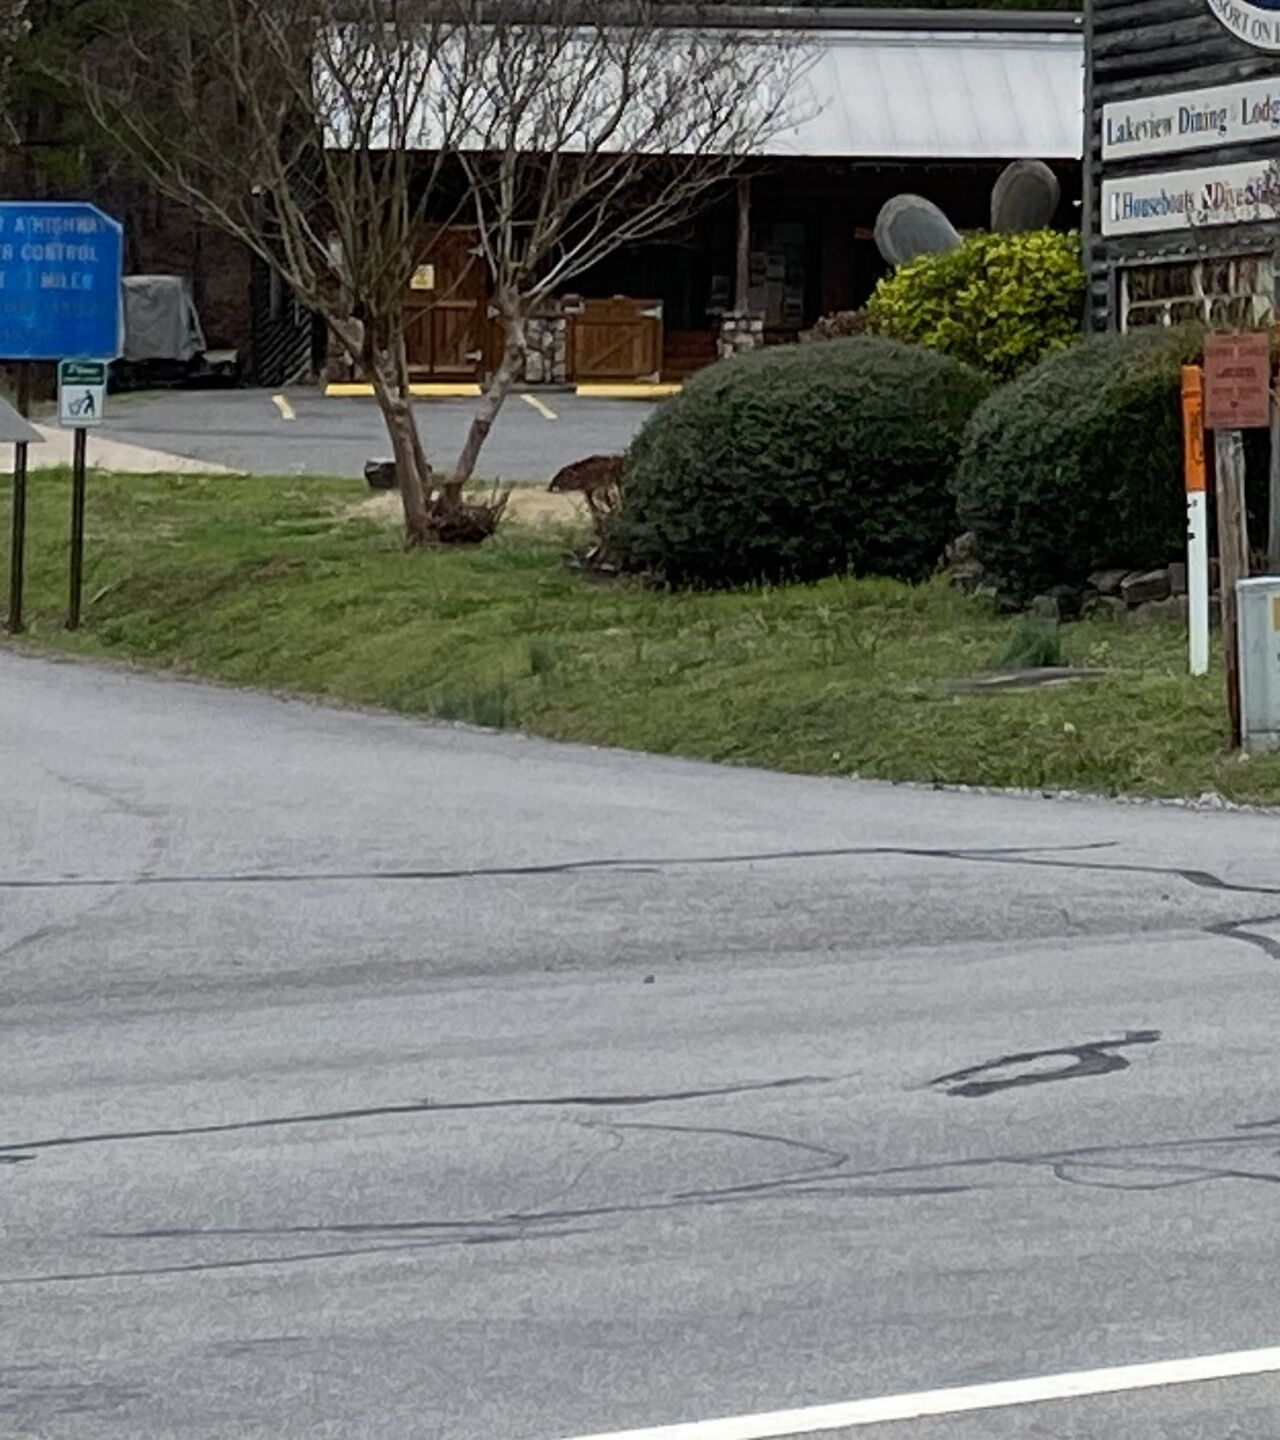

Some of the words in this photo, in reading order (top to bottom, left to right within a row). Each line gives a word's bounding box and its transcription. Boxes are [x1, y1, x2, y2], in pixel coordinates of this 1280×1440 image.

[1252, 19, 1272, 42] ON
[1106, 114, 1173, 146] Lakeview
[1178, 104, 1228, 137] Dining
[1121, 188, 1195, 220] Houseboats
